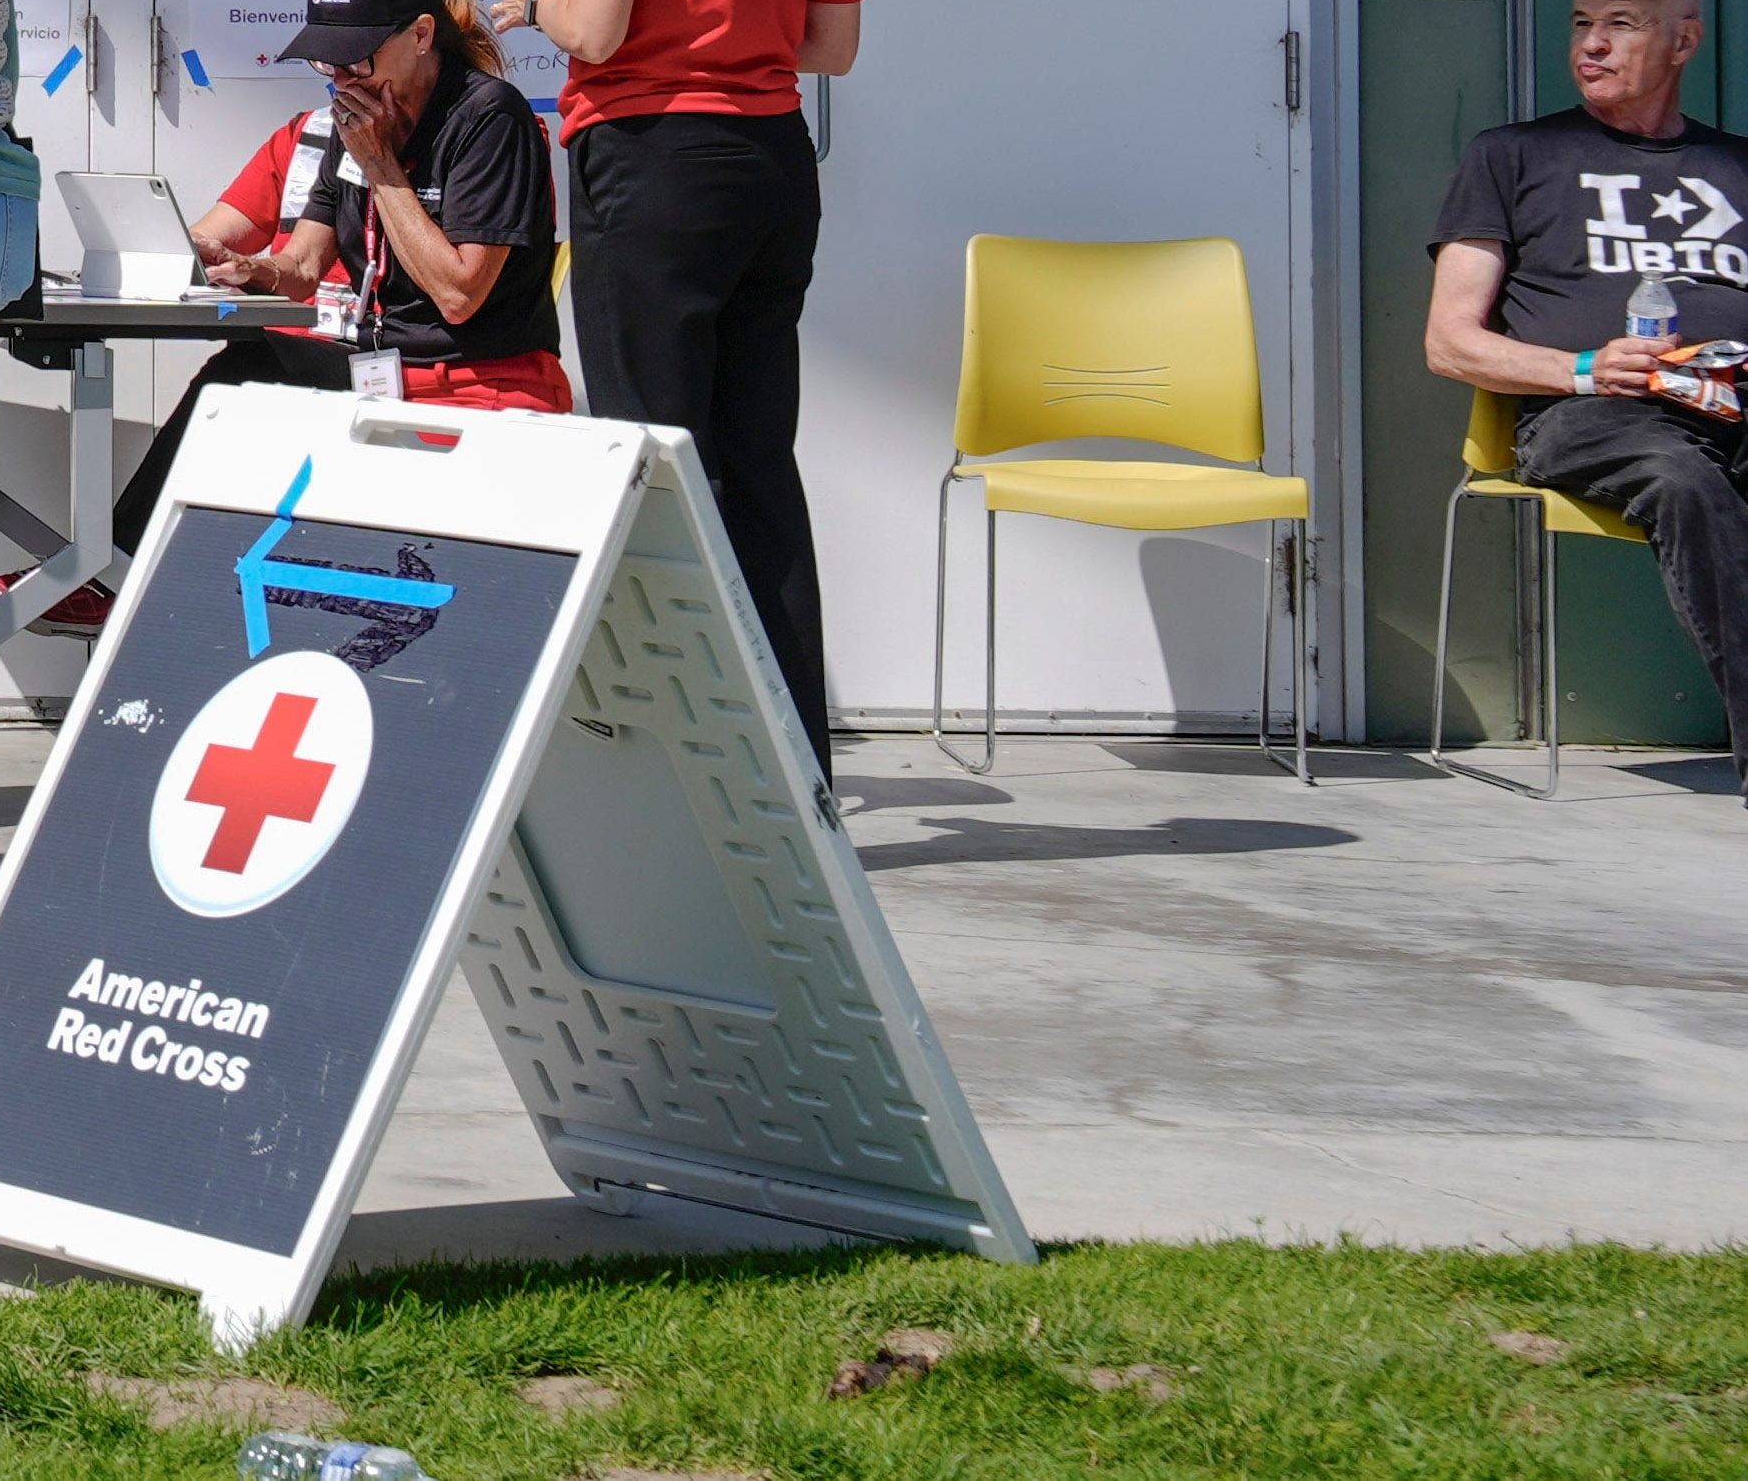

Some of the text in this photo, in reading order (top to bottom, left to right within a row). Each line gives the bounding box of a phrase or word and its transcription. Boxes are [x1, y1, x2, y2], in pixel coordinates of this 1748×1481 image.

[19, 26, 61, 39] rvicio
[229, 9, 308, 23] Bienveni
[67, 958, 271, 1040] American
[46, 1007, 252, 1093] Red Cross
